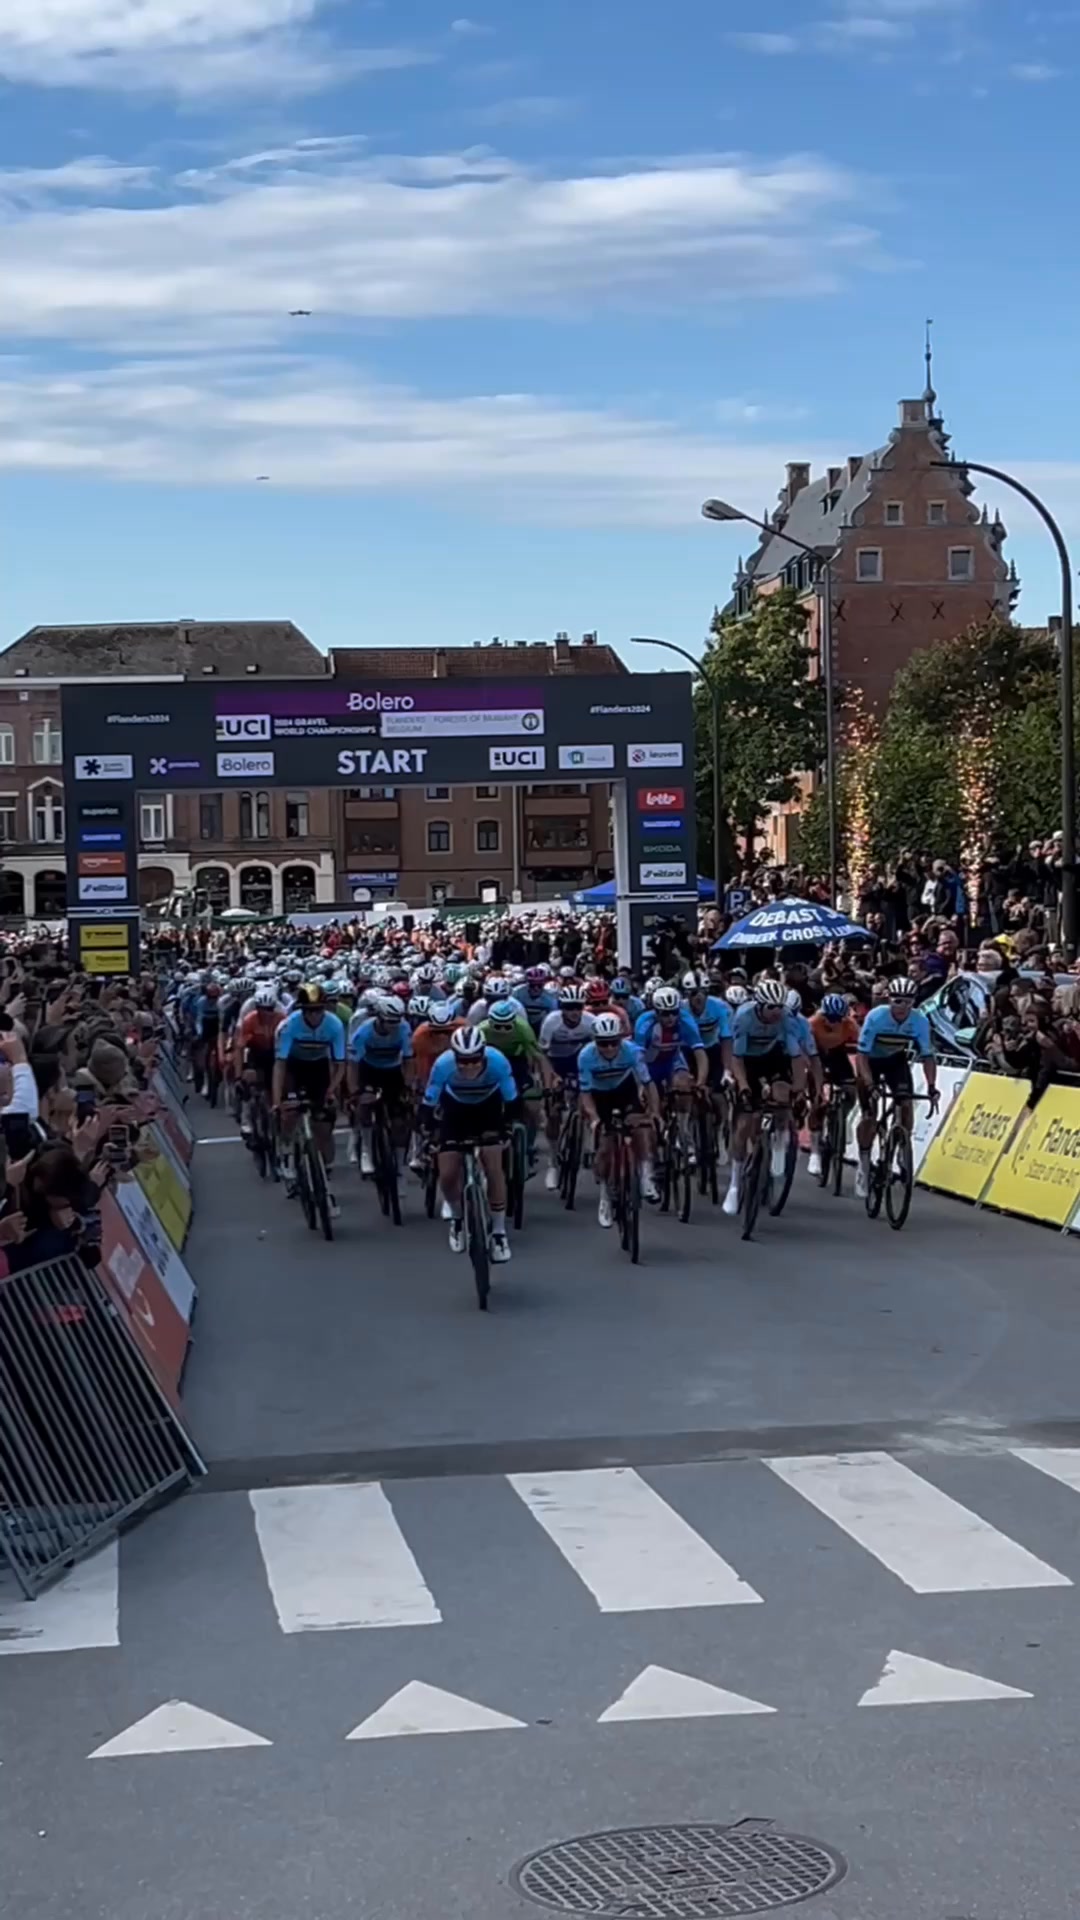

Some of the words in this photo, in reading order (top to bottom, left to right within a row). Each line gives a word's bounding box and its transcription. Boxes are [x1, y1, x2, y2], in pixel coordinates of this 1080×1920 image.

[346, 692, 415, 710] Bolero
[590, 704, 651, 714] #Flanders2024
[107, 713, 170, 723] #Flanders2024
[225, 719, 266, 735] UCI
[274, 727, 305, 735] WORLD
[222, 757, 271, 771] Bolero
[337, 749, 428, 775] START
[502, 750, 537, 766] UCI
[646, 792, 676, 805] lotto
[730, 891, 744, 909] P
[749, 909, 823, 927] DEBAST
[782, 925, 833, 941] CROSS
[964, 1102, 1012, 1141] Flanders
